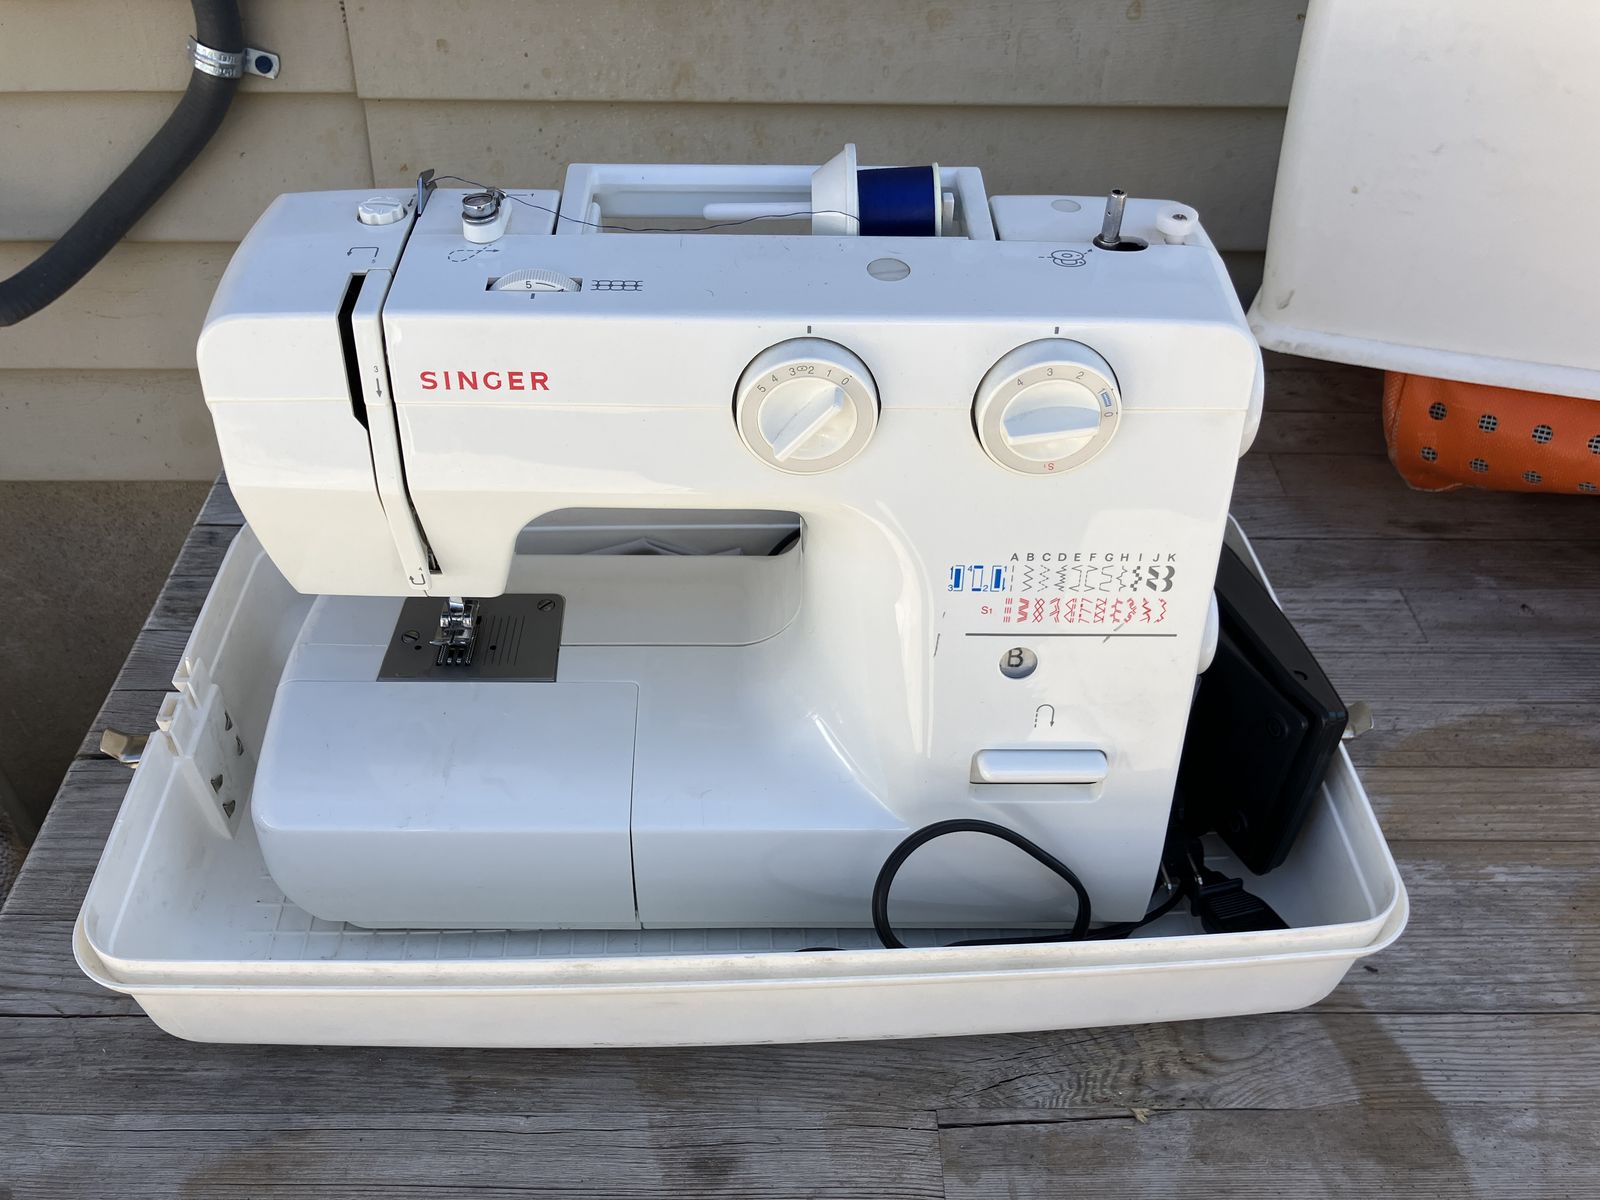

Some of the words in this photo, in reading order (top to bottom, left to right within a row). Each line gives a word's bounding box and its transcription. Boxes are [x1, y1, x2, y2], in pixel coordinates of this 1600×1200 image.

[525, 280, 532, 289] 5
[373, 365, 379, 373] 3
[419, 371, 550, 391] SINGER
[757, 385, 767, 393] 5
[770, 374, 779, 382] 4
[789, 367, 796, 376] 3
[807, 366, 815, 375] 2
[826, 369, 832, 377] 1
[1017, 378, 1023, 386] 4
[1046, 368, 1053, 376] 3
[1076, 371, 1085, 380] 2
[1010, 552, 1019, 562] A
[1026, 552, 1035, 562] B
[1042, 552, 1052, 562] C
[1057, 552, 1067, 562] D
[1073, 552, 1082, 562] E
[1089, 552, 1097, 562] F
[1104, 552, 1114, 562] G
[1120, 553, 1129, 562] H
[1138, 553, 1143, 562] I
[1152, 553, 1160, 562] J
[1167, 553, 1176, 562] K
[947, 584, 954, 592] 3
[982, 584, 989, 592] 2
[980, 605, 993, 615] S1
[1007, 647, 1024, 667] B
